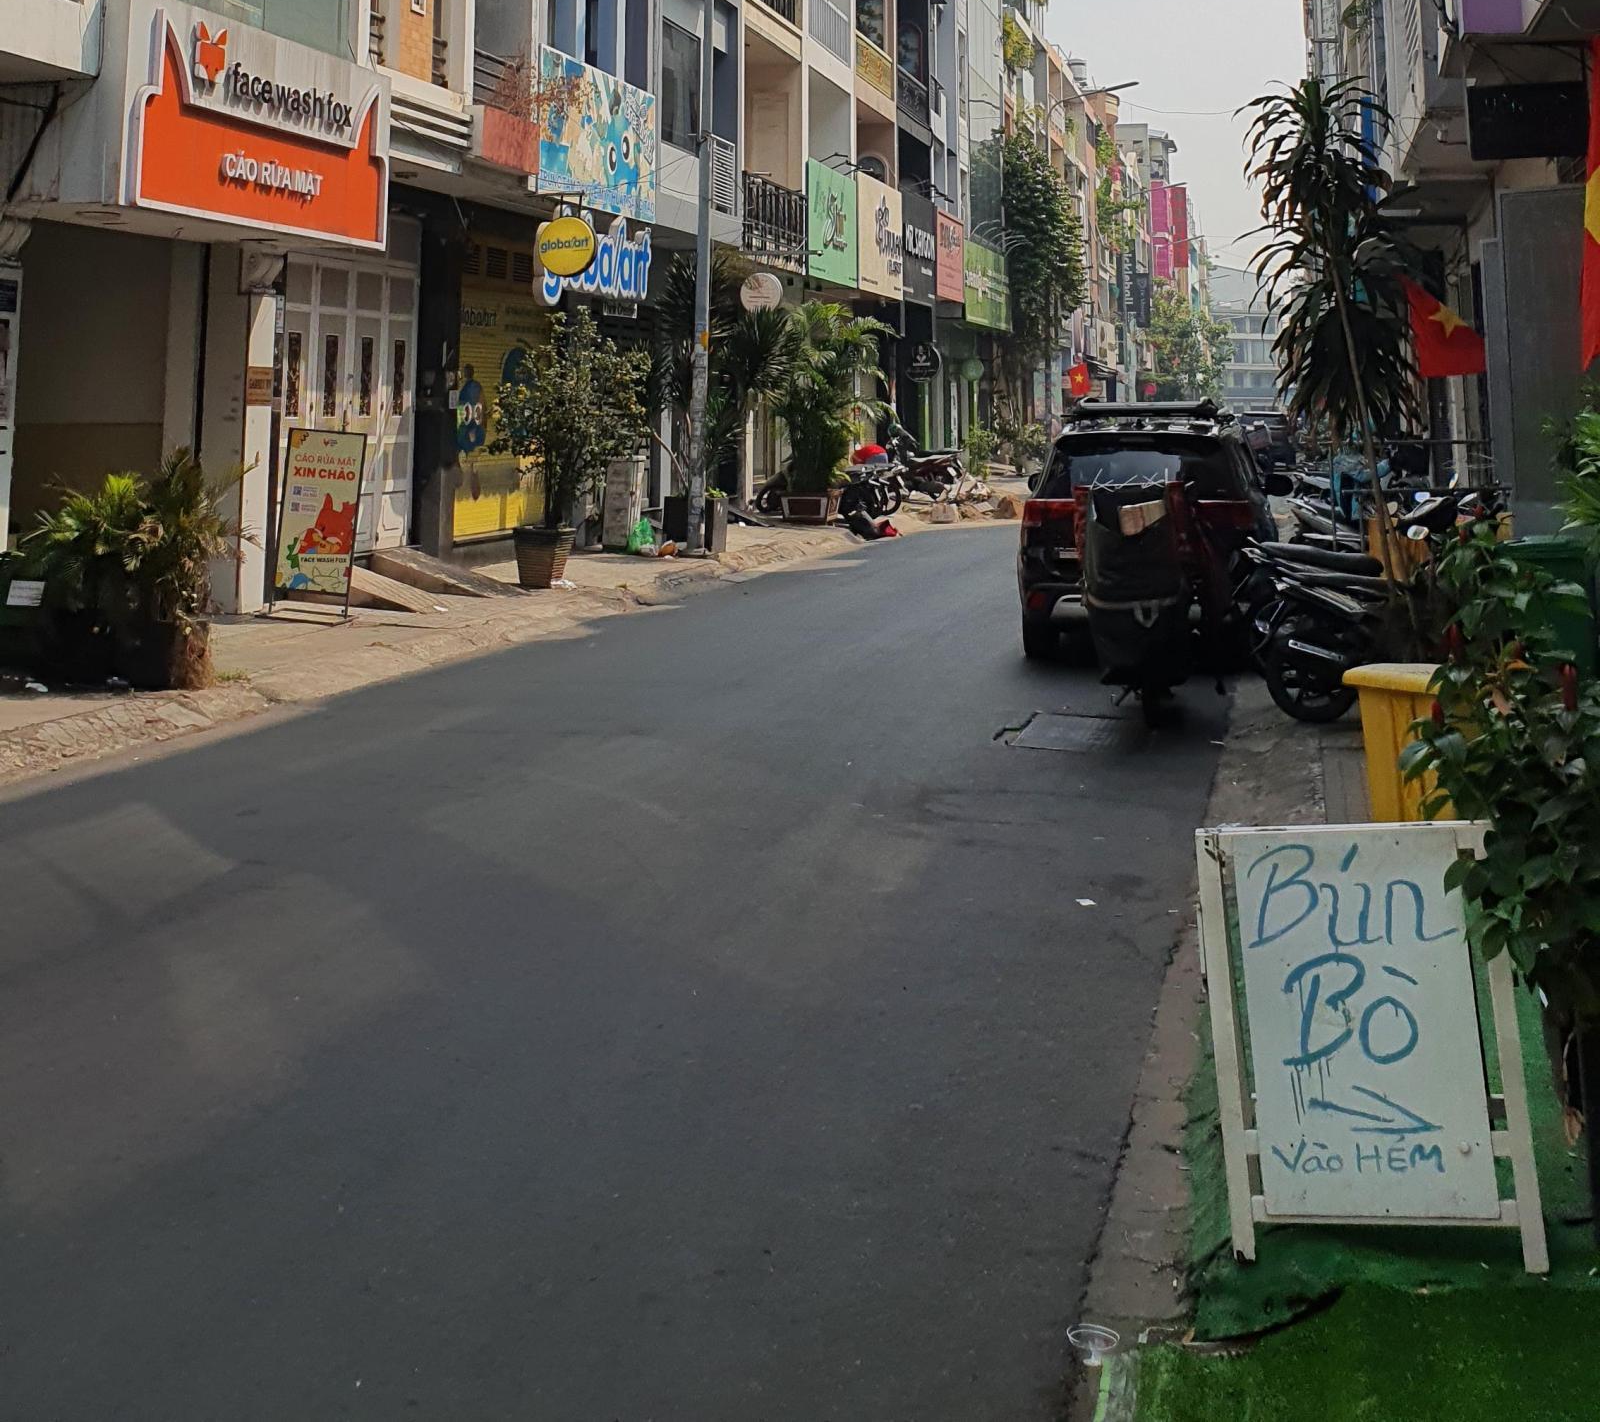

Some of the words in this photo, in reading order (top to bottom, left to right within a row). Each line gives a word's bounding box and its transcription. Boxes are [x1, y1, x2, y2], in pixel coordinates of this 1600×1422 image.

[232, 61, 273, 104] face
[275, 83, 323, 119] wash
[326, 92, 353, 128] fox
[225, 150, 259, 182] CÁO
[541, 236, 589, 254] globalart
[293, 466, 316, 478] XIN
[294, 452, 315, 464] CÁO
[1247, 842, 1459, 949] Bún
[1281, 951, 1419, 1067] Bò
[1271, 1136, 1344, 1175] Vào
